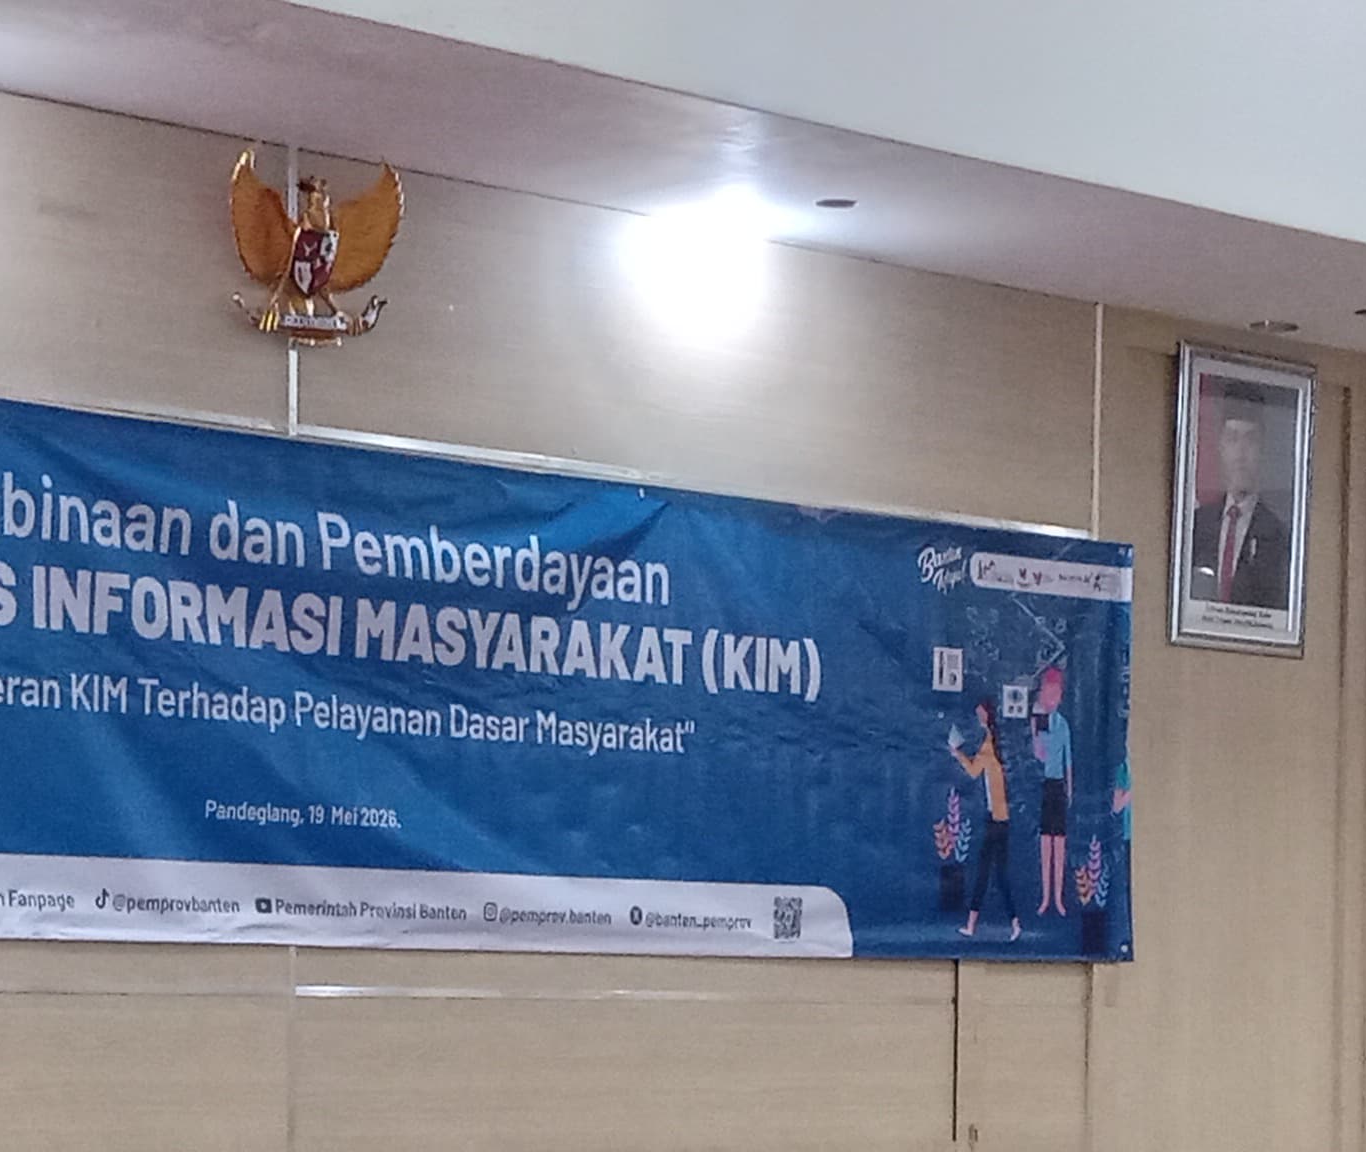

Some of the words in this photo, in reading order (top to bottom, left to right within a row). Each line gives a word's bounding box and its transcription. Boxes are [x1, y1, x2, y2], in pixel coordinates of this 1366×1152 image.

[209, 500, 306, 569] dan
[318, 511, 670, 611] Pemberdayaan
[33, 566, 344, 657] INFORMASI
[355, 597, 693, 686] MASYARAKAT
[702, 627, 823, 703] (KIM)
[70, 673, 129, 714] KIM
[138, 678, 287, 733] Terhadap
[294, 691, 442, 741] Pelayanan
[449, 703, 530, 742] Dasar
[536, 710, 696, 756] Masyarakat"
[204, 799, 305, 828] Pandeglang,
[308, 804, 326, 825] 19
[331, 806, 359, 827] Mei
[9, 890, 75, 912] Fanpage
[112, 896, 241, 916] @pemprovbanten
[275, 898, 358, 918] Pemerintah
[361, 901, 417, 920] Provinsi
[419, 903, 468, 921] Banten
